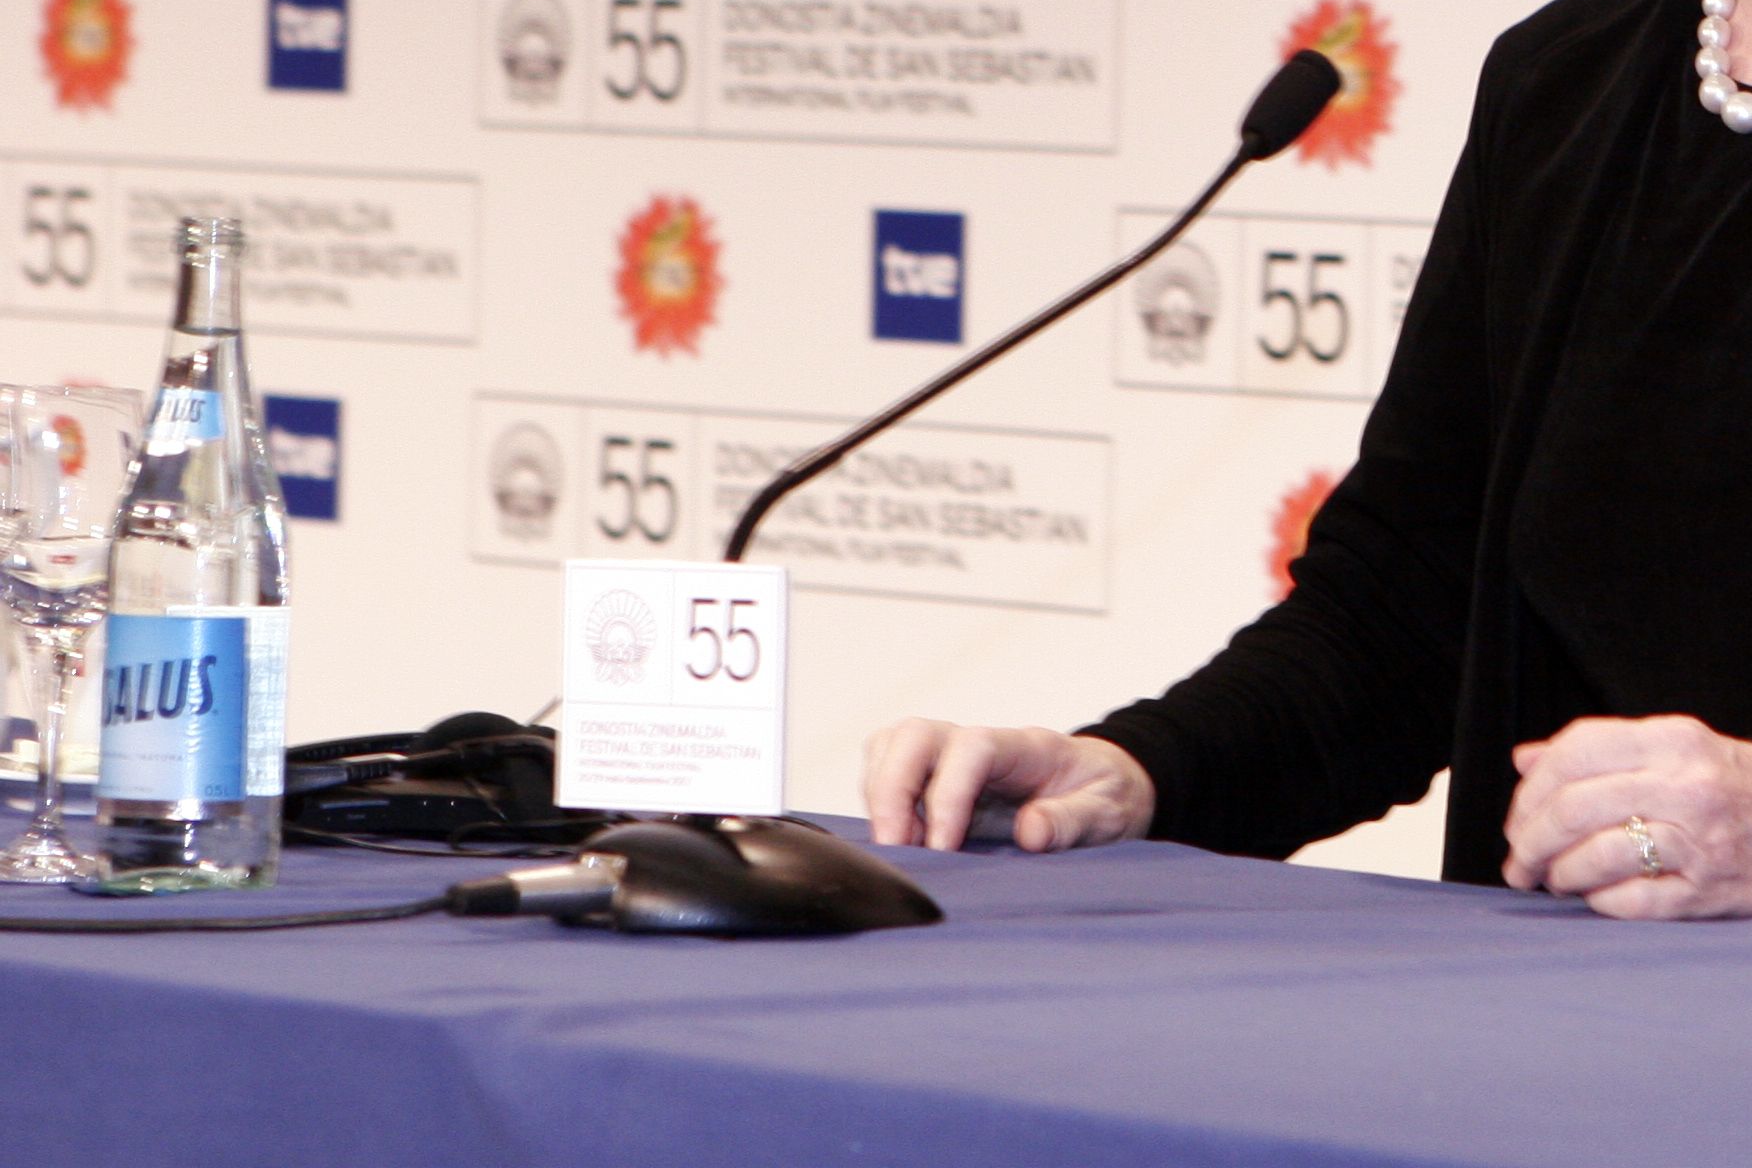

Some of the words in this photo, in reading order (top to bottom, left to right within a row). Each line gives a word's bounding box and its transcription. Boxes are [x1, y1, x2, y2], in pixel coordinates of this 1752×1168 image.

[21, 187, 96, 287] 55
[882, 247, 958, 298] tve
[1256, 251, 1351, 365] 55
[595, 436, 679, 544] 55
[684, 597, 762, 681] 55
